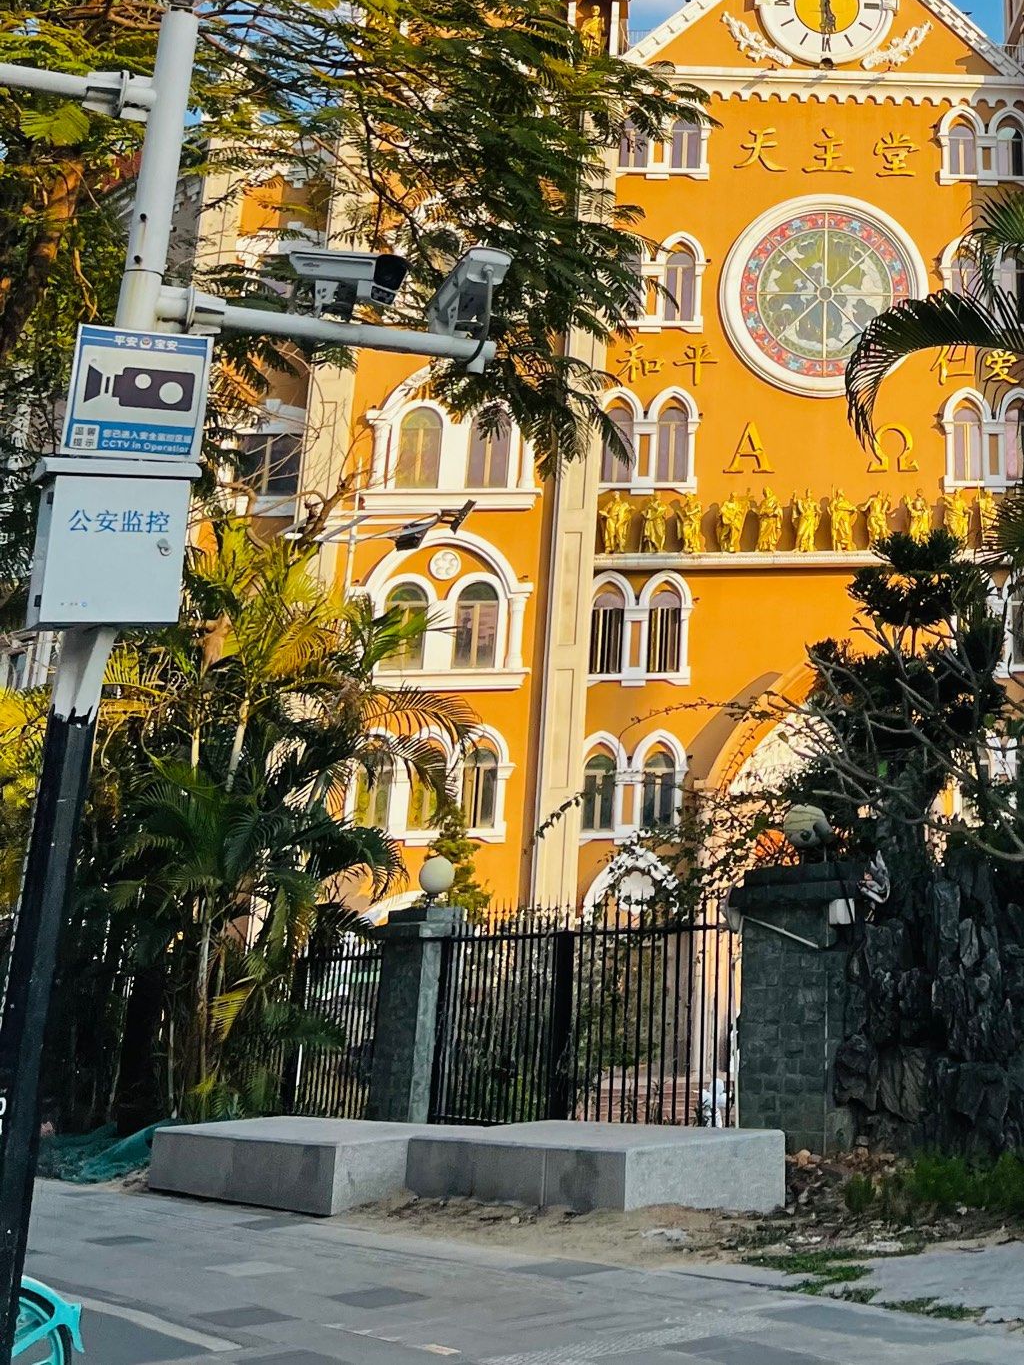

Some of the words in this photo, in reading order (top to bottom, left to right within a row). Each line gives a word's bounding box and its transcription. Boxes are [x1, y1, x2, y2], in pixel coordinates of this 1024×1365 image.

[733, 127, 919, 177] 天主堂
[616, 342, 719, 386] 和平
[930, 343, 1019, 385] 仁爱
[101, 439, 130, 448] CCTV
[132, 441, 141, 449] in
[723, 421, 775, 473] A
[867, 422, 919, 472] Ω
[68, 509, 170, 534] 公安监控
